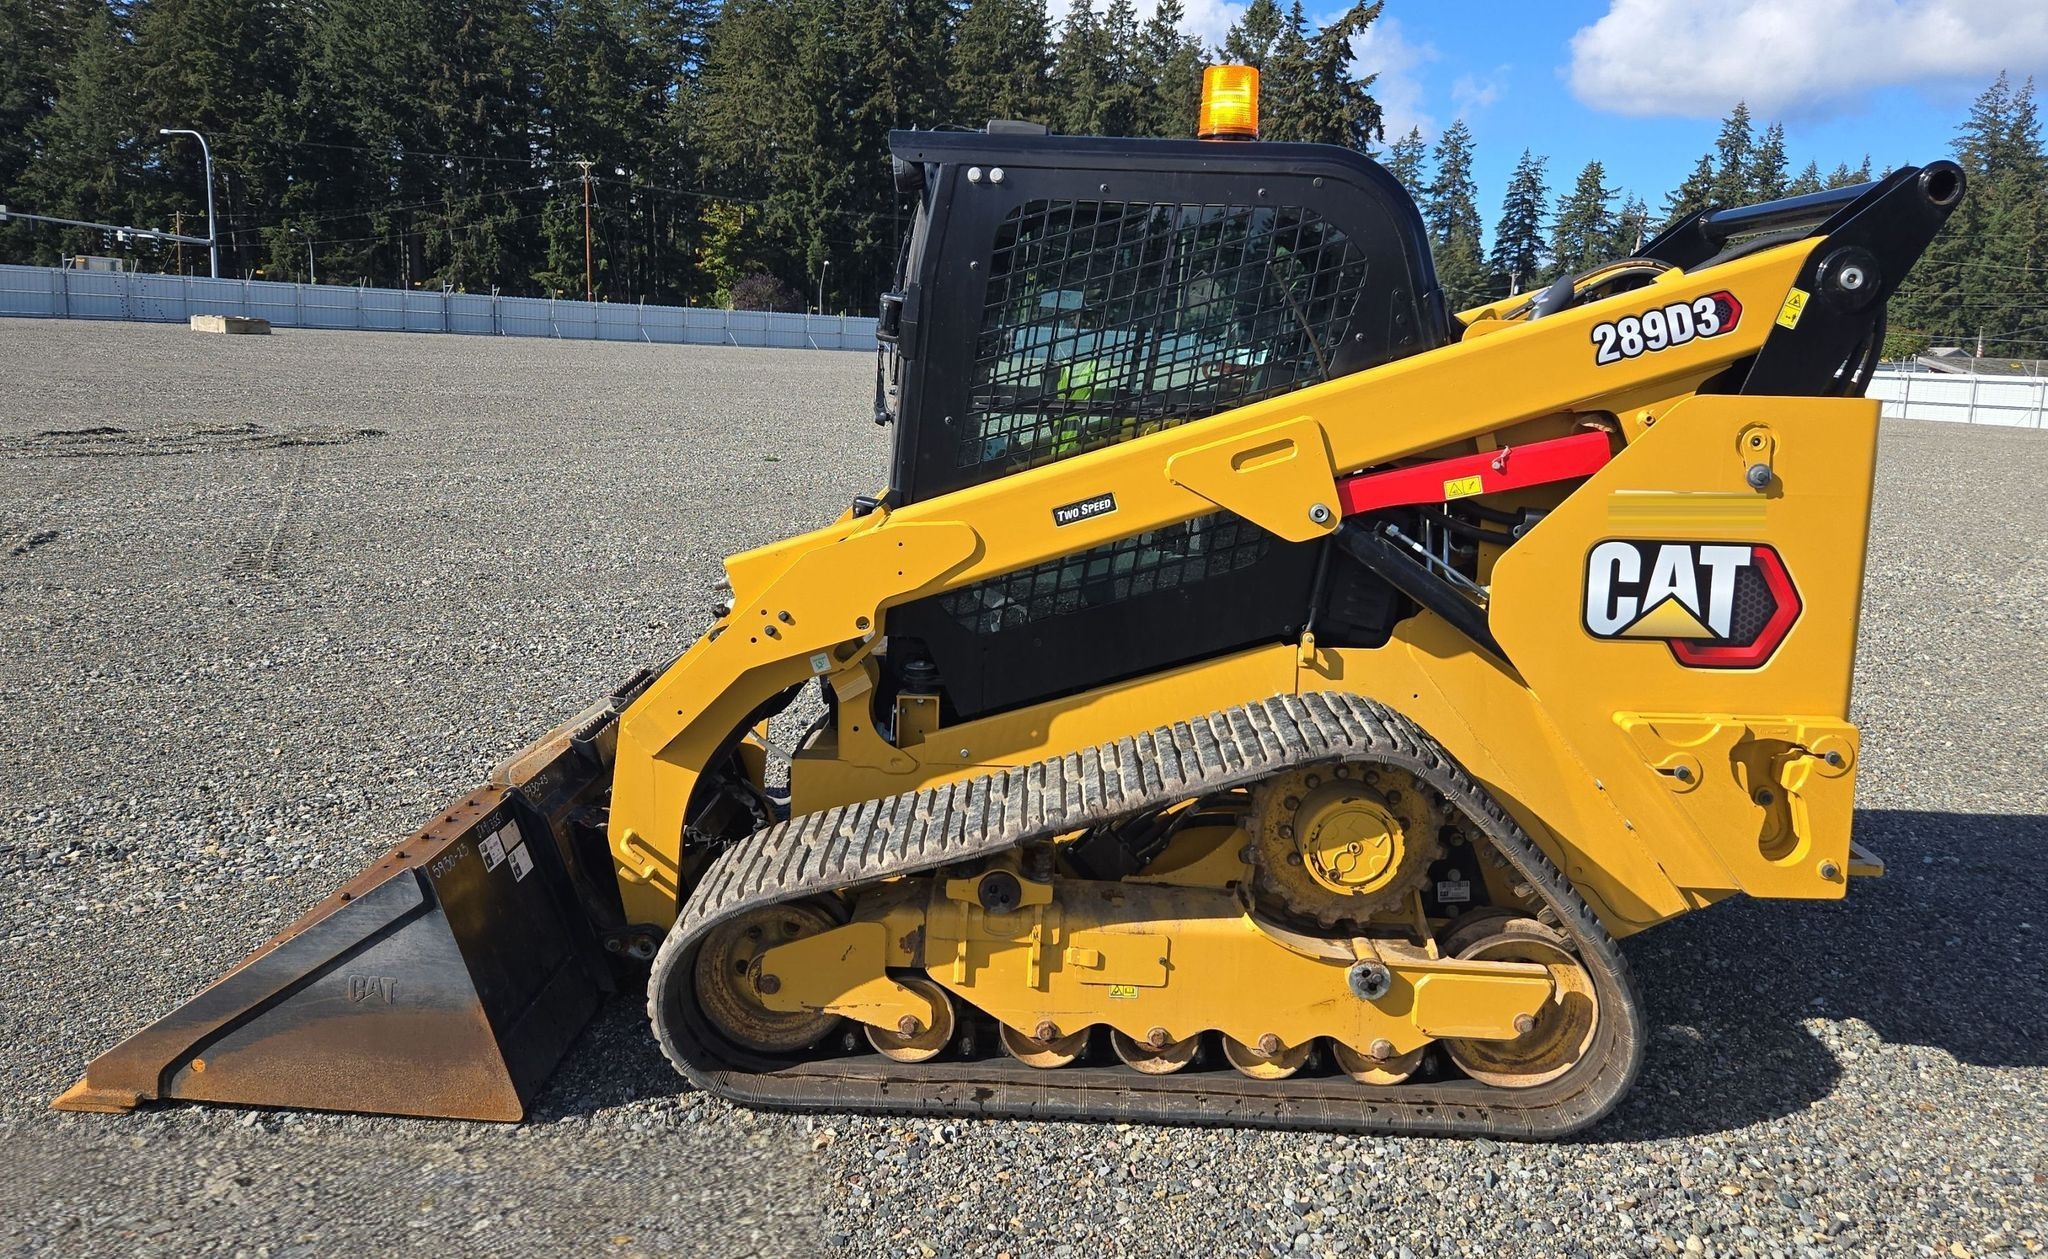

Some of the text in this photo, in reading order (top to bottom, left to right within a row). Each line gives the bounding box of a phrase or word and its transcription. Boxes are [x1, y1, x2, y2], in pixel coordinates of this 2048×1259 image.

[1592, 296, 1721, 364] 289D3
[1057, 498, 1111, 522] TWO SPEED
[1586, 541, 1752, 639] CAT
[348, 974, 398, 1005] CAT
